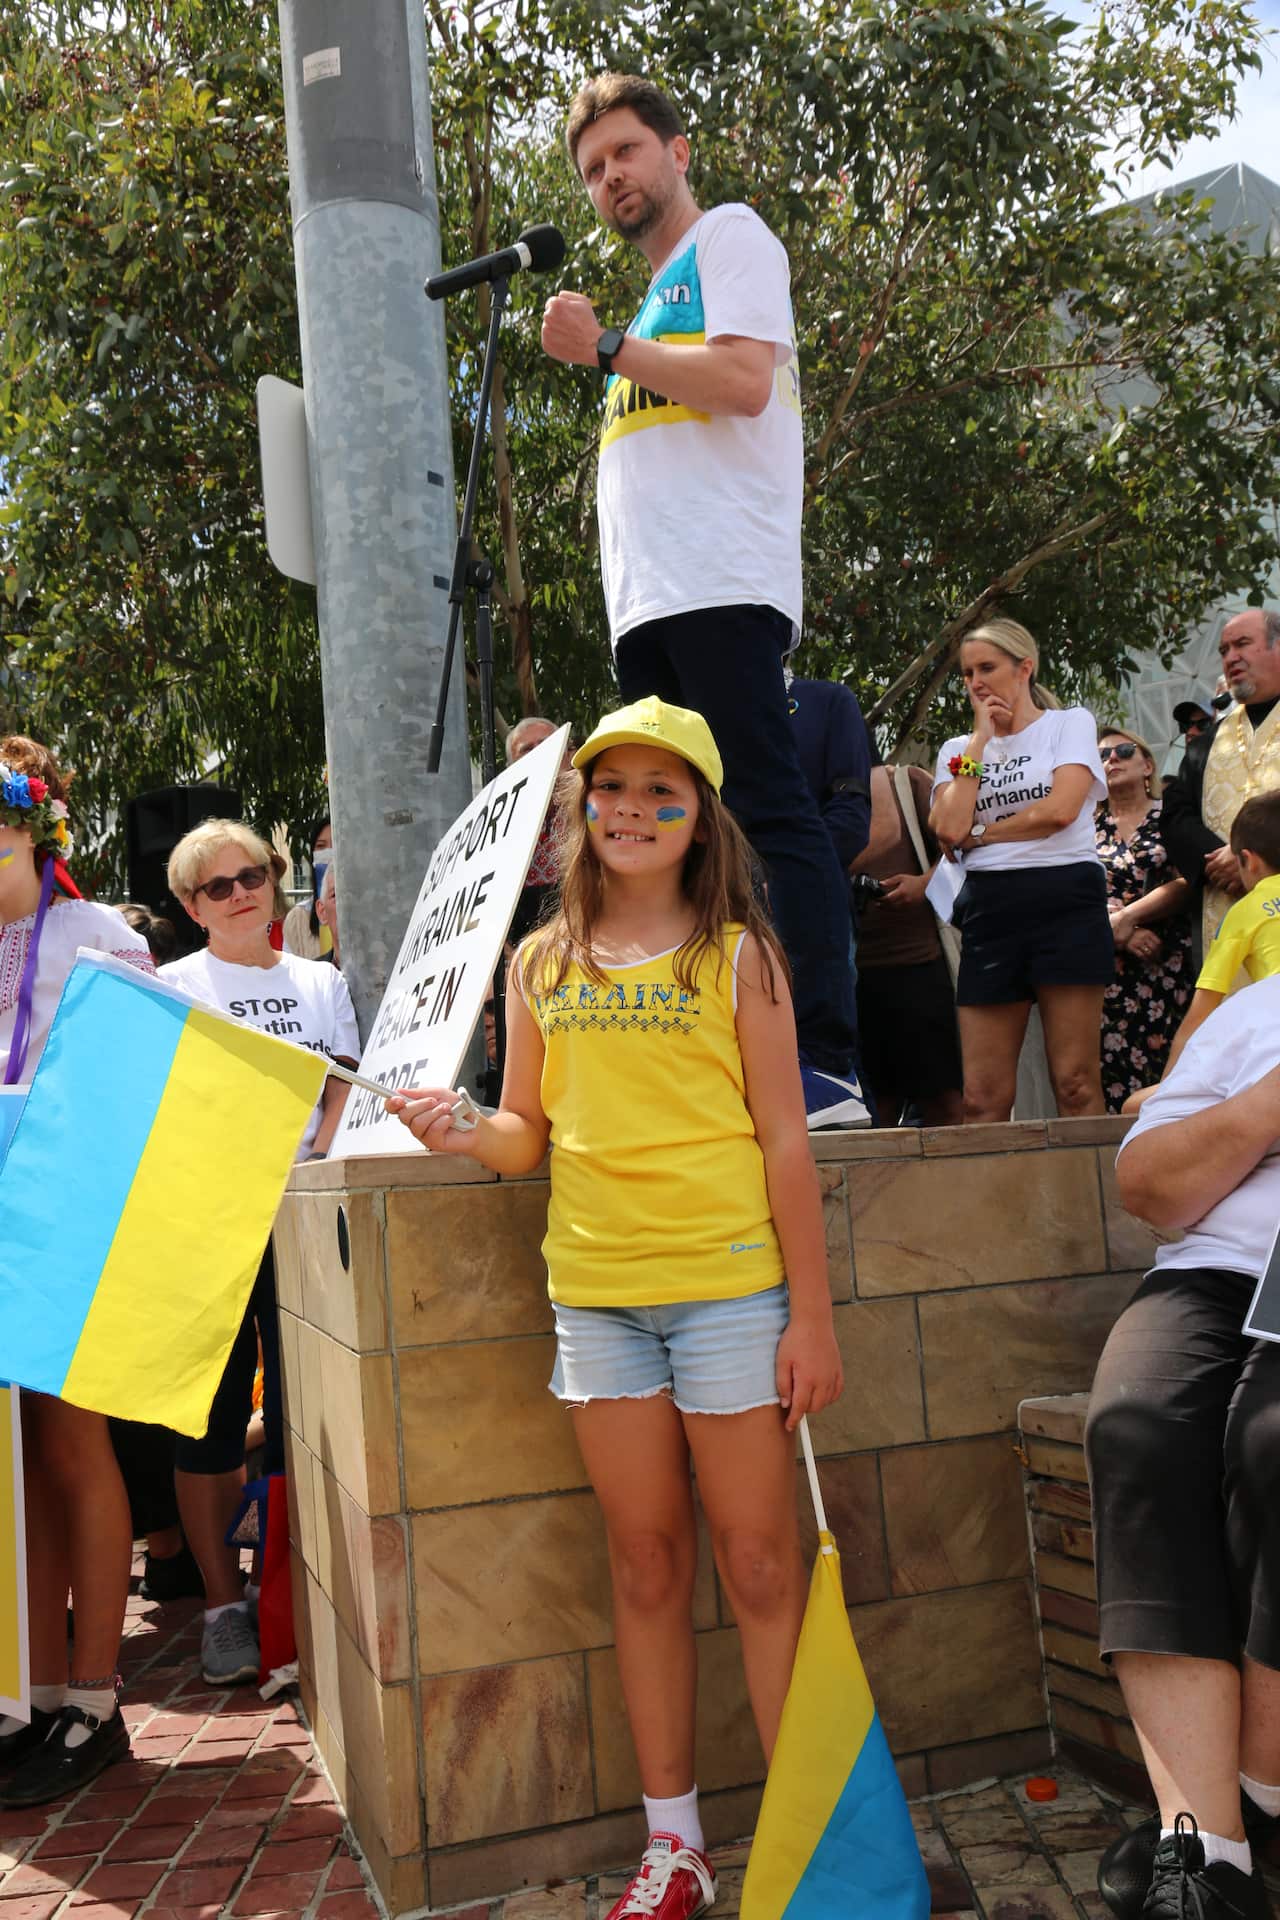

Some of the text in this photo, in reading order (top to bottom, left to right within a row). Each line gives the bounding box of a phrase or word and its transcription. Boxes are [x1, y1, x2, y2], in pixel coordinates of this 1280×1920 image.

[983, 755, 1032, 774] STOP
[994, 782, 1052, 807] hands
[423, 776, 529, 902] SUPPORT
[398, 870, 496, 975] UKRAINE
[229, 998, 298, 1018] STOP
[370, 961, 467, 1054] PEACE IN
